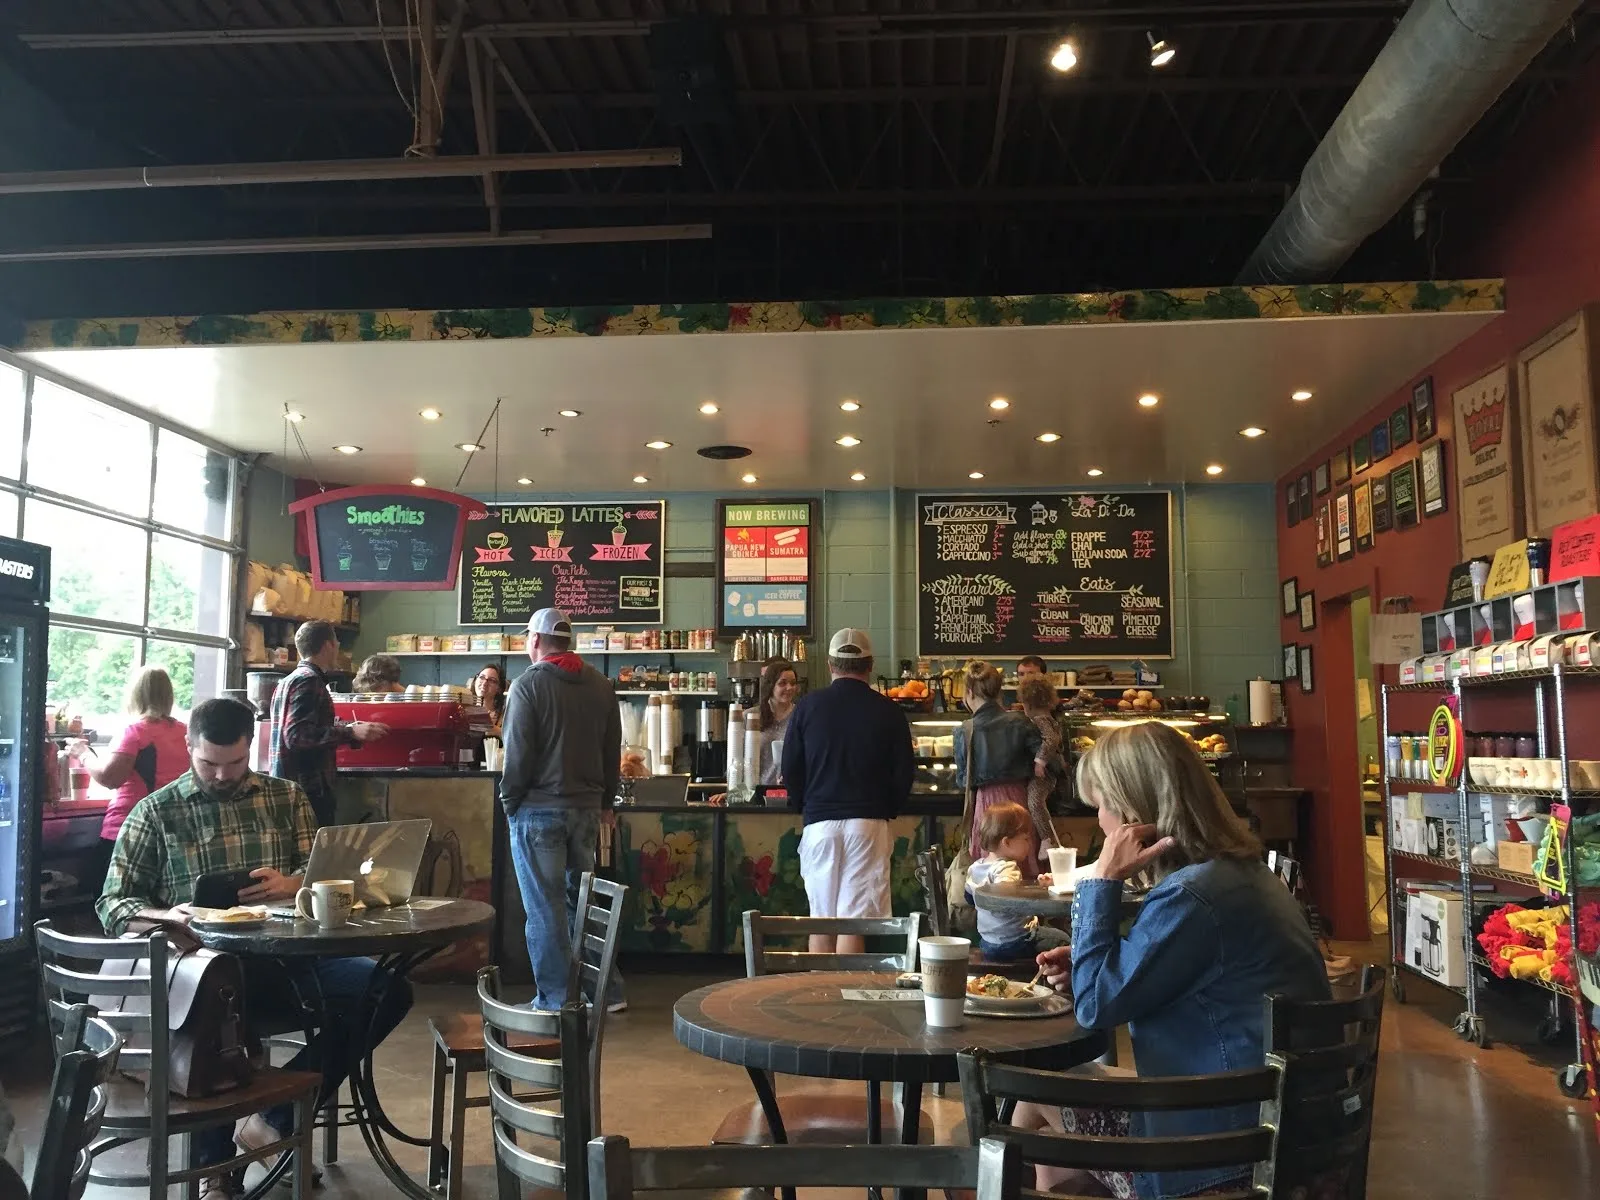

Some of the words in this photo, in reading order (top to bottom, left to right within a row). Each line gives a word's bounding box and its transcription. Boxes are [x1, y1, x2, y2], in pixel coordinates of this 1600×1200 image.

[346, 505, 425, 526] Smoothies
[501, 507, 565, 524] FLAVORED
[572, 507, 625, 523] LATTES
[728, 510, 752, 520] NOW
[756, 509, 806, 520] BREWING
[937, 504, 1005, 519] Classics
[943, 524, 988, 535] ESPRESSO
[942, 534, 986, 544] MACCHIATO
[1070, 531, 1107, 542] FRAPPE
[750, 543, 766, 551] NEW
[769, 547, 804, 555] SUMATRA
[942, 543, 980, 552] CORTADO
[1071, 541, 1093, 551] CHAI
[483, 551, 504, 560] HOT
[540, 549, 563, 559] ICED
[602, 546, 640, 559] FROZEN
[942, 551, 991, 561] CAPPUCCINO
[1071, 549, 1104, 559] ITALIAN
[1104, 548, 1128, 559] SODA
[1071, 558, 1092, 569] TEA
[471, 566, 511, 577] Flavors
[552, 564, 570, 576] Our
[931, 579, 1005, 596] Standards
[1079, 576, 1116, 591] Eats
[941, 595, 984, 606] AMERICANO
[1036, 593, 1072, 603] TURKEY
[1121, 596, 1164, 608] SEASONAL
[940, 605, 968, 615] LATTE
[1040, 610, 1069, 620] CUBAN
[1079, 615, 1114, 626] CHICKEN
[1122, 614, 1161, 625] PIMENTO
[940, 623, 968, 633] FRENCH
[969, 623, 995, 635] PRESS
[1037, 625, 1070, 636] VEGGIE
[1083, 624, 1111, 635] SALAD
[1125, 625, 1158, 636] CHEESE
